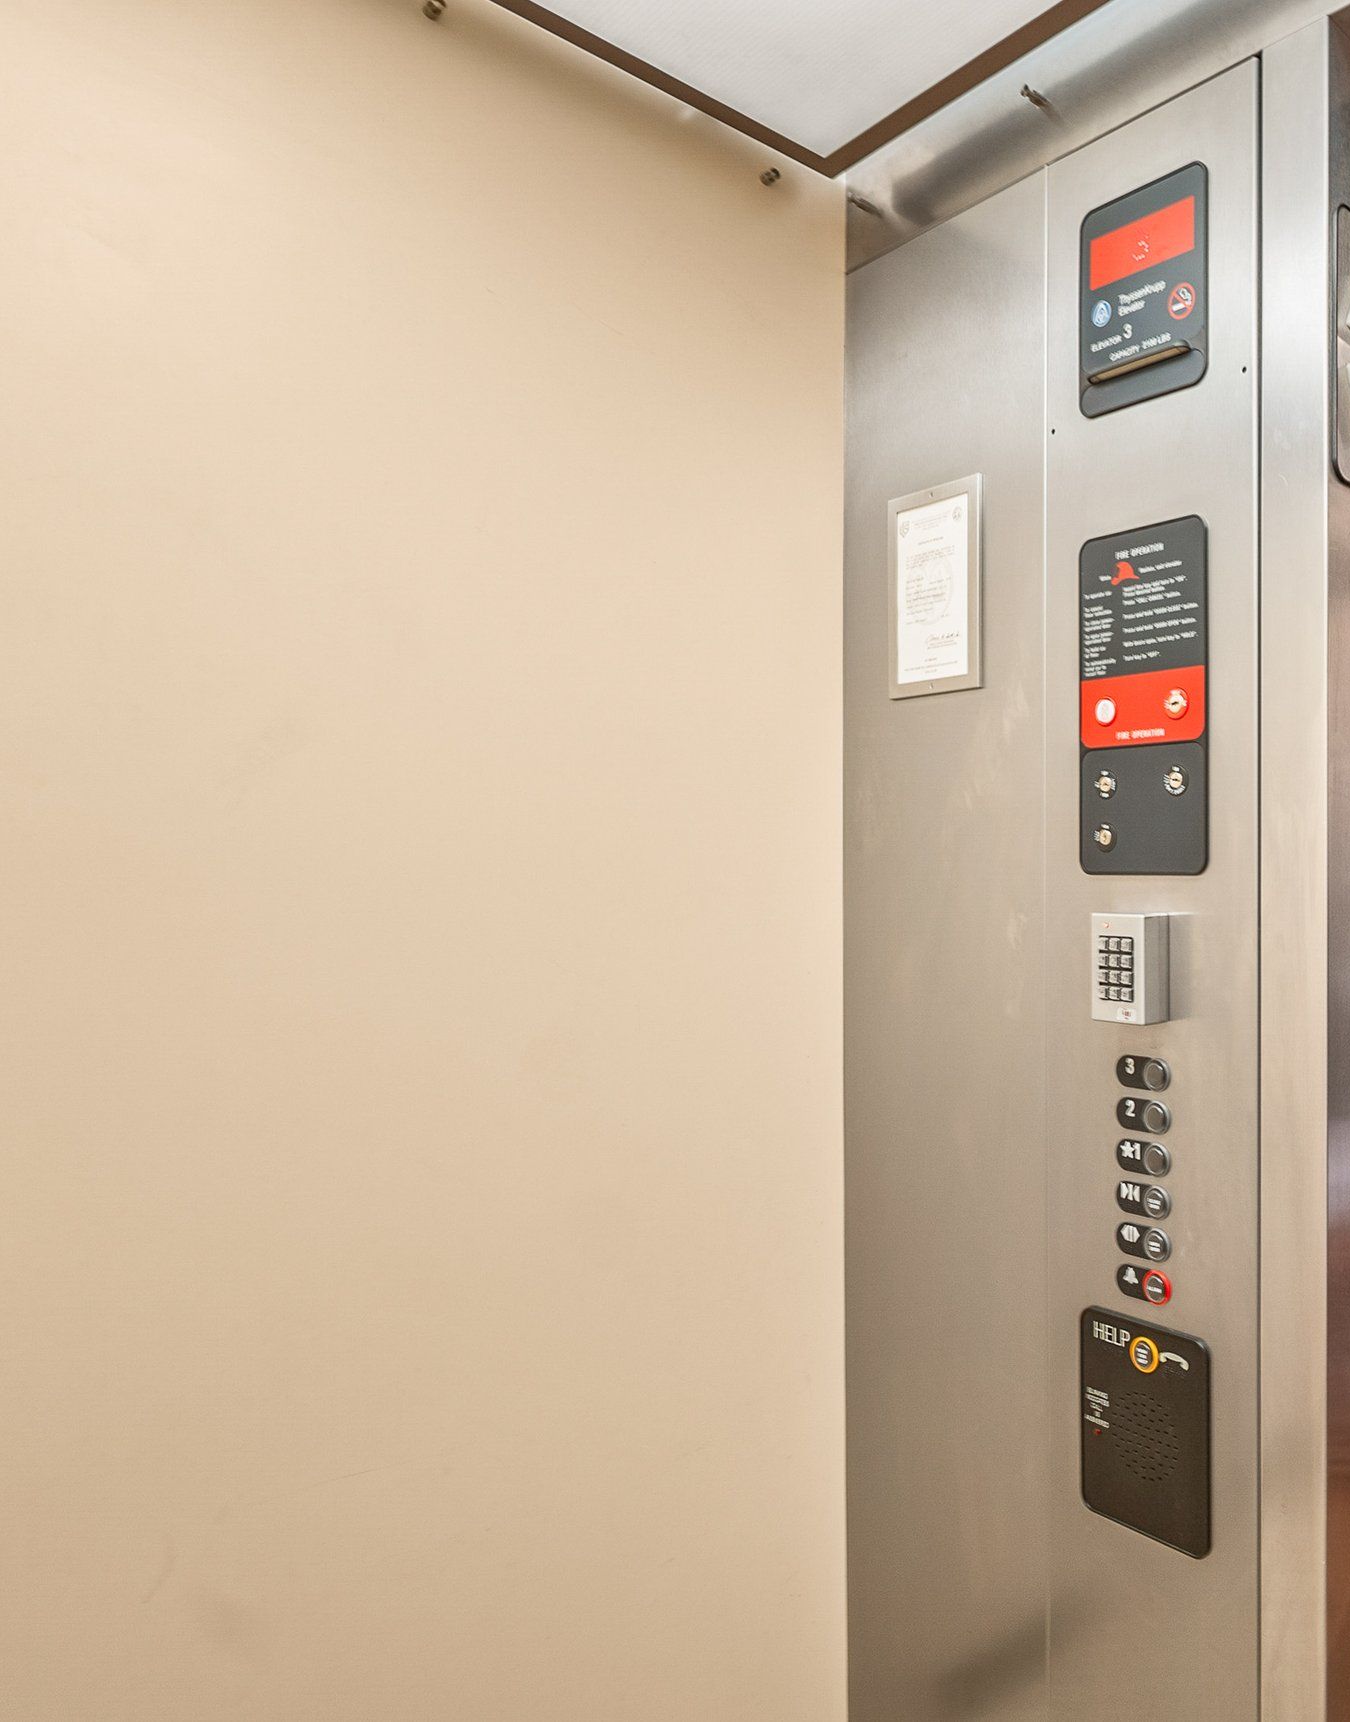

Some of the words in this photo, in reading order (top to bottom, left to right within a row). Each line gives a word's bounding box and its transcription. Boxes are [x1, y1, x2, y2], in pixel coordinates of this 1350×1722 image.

[1122, 323, 1133, 339] 3
[1129, 542, 1165, 557] OPERATION
[1124, 1057, 1136, 1075] 3
[1124, 1099, 1136, 1117] 2
[1092, 1320, 1131, 1348] HELP
